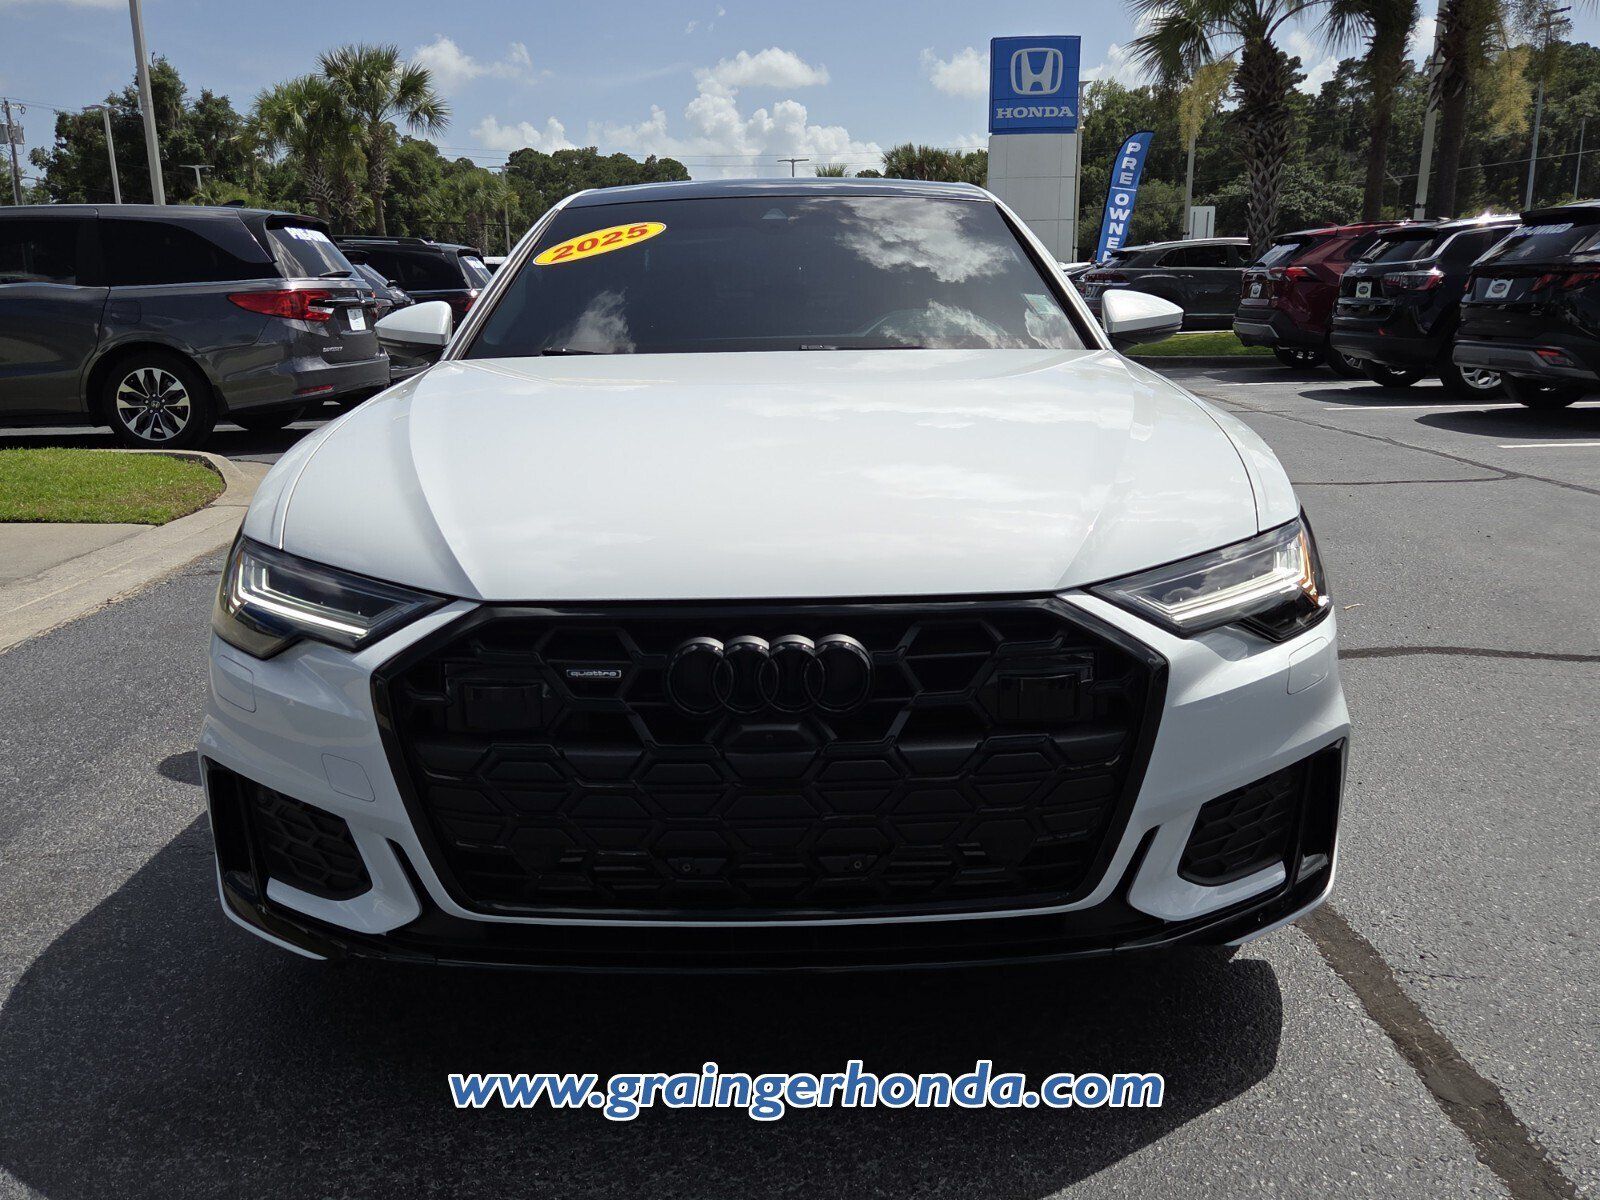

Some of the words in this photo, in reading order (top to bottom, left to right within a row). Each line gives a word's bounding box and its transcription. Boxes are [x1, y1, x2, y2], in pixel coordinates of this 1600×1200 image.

[996, 106, 1074, 118] HONDA
[1119, 142, 1142, 185] PRE
[551, 224, 649, 262] 2025
[570, 670, 617, 678] quattro
